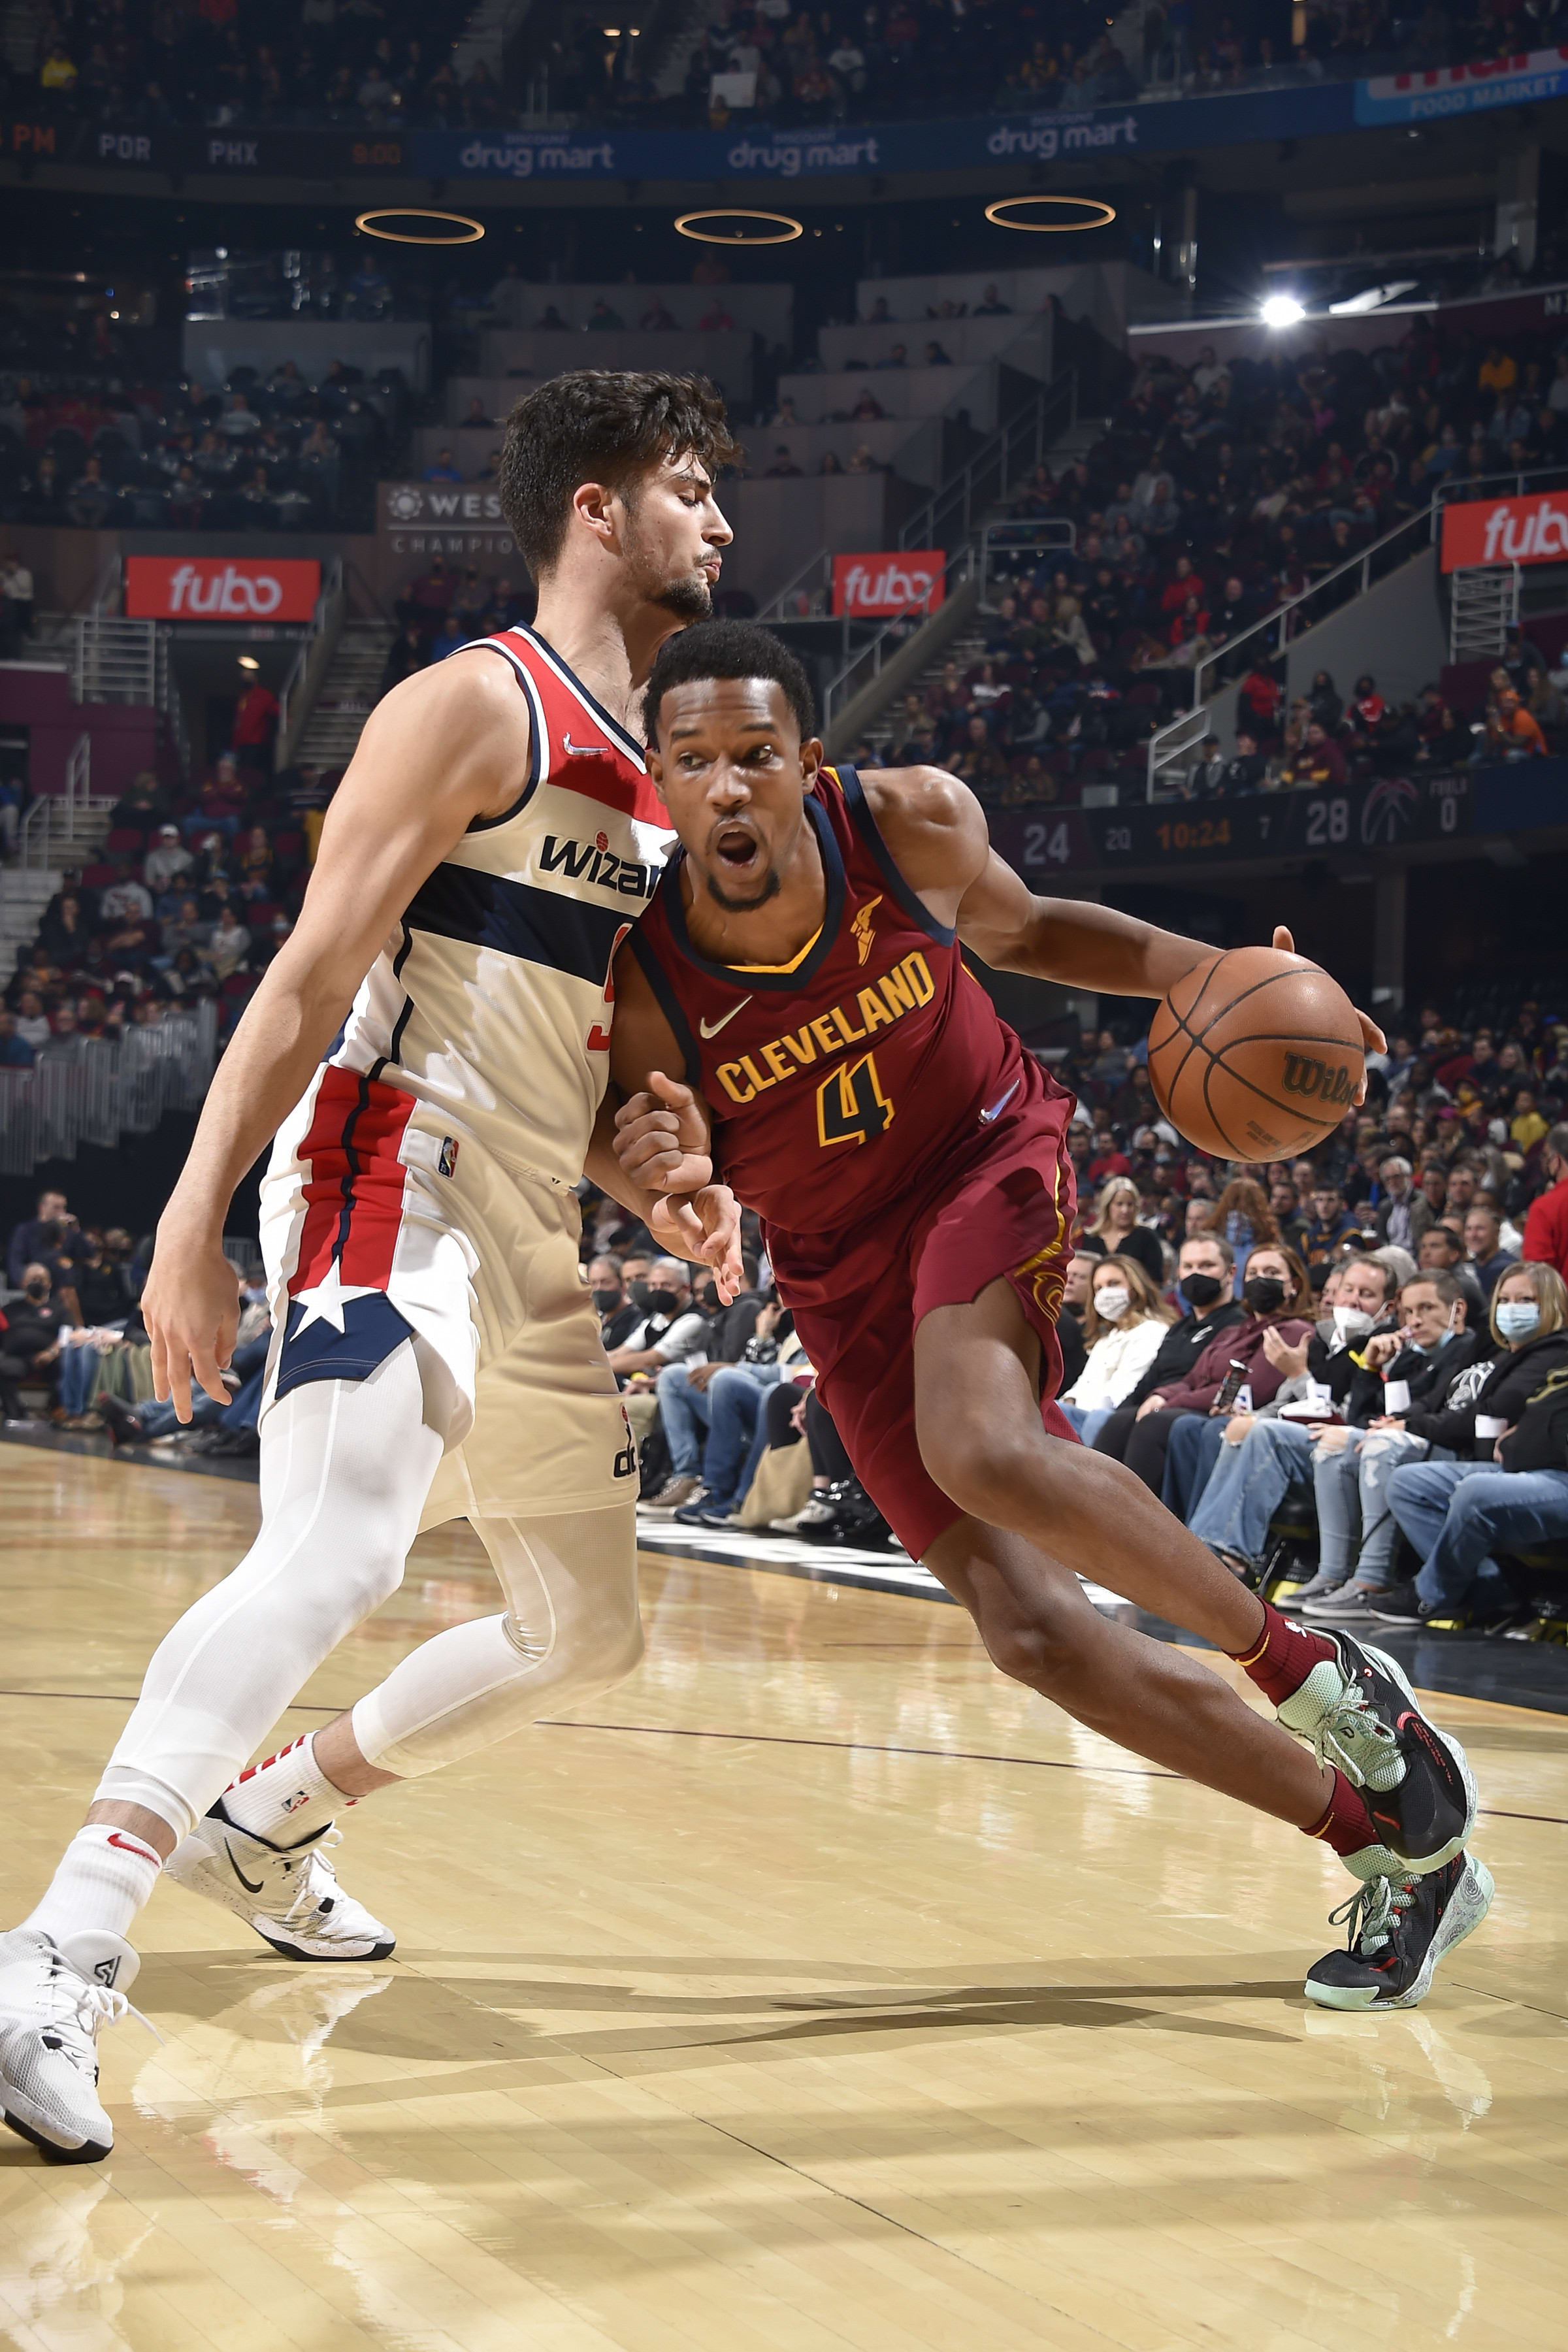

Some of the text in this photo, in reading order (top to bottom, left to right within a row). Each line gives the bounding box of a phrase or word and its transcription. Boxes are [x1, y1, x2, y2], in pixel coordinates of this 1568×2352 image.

[1409, 75, 1560, 118] FOOD MARKET
[14, 123, 56, 153] PM
[208, 139, 258, 165] PHX
[460, 140, 615, 176] drug mart
[727, 137, 879, 176] drug mart
[987, 115, 1138, 159] drug mart
[1482, 499, 1568, 562] fub
[169, 563, 284, 615] fubo
[843, 563, 933, 606] fubo
[1022, 821, 1071, 866] 24
[1156, 817, 1232, 851] 10:24
[1306, 796, 1350, 845] 28
[1440, 796, 1458, 833] 0
[715, 951, 936, 1104] CLEVELAND
[817, 1051, 895, 1147] 4
[1282, 1051, 1359, 1105] Wils
